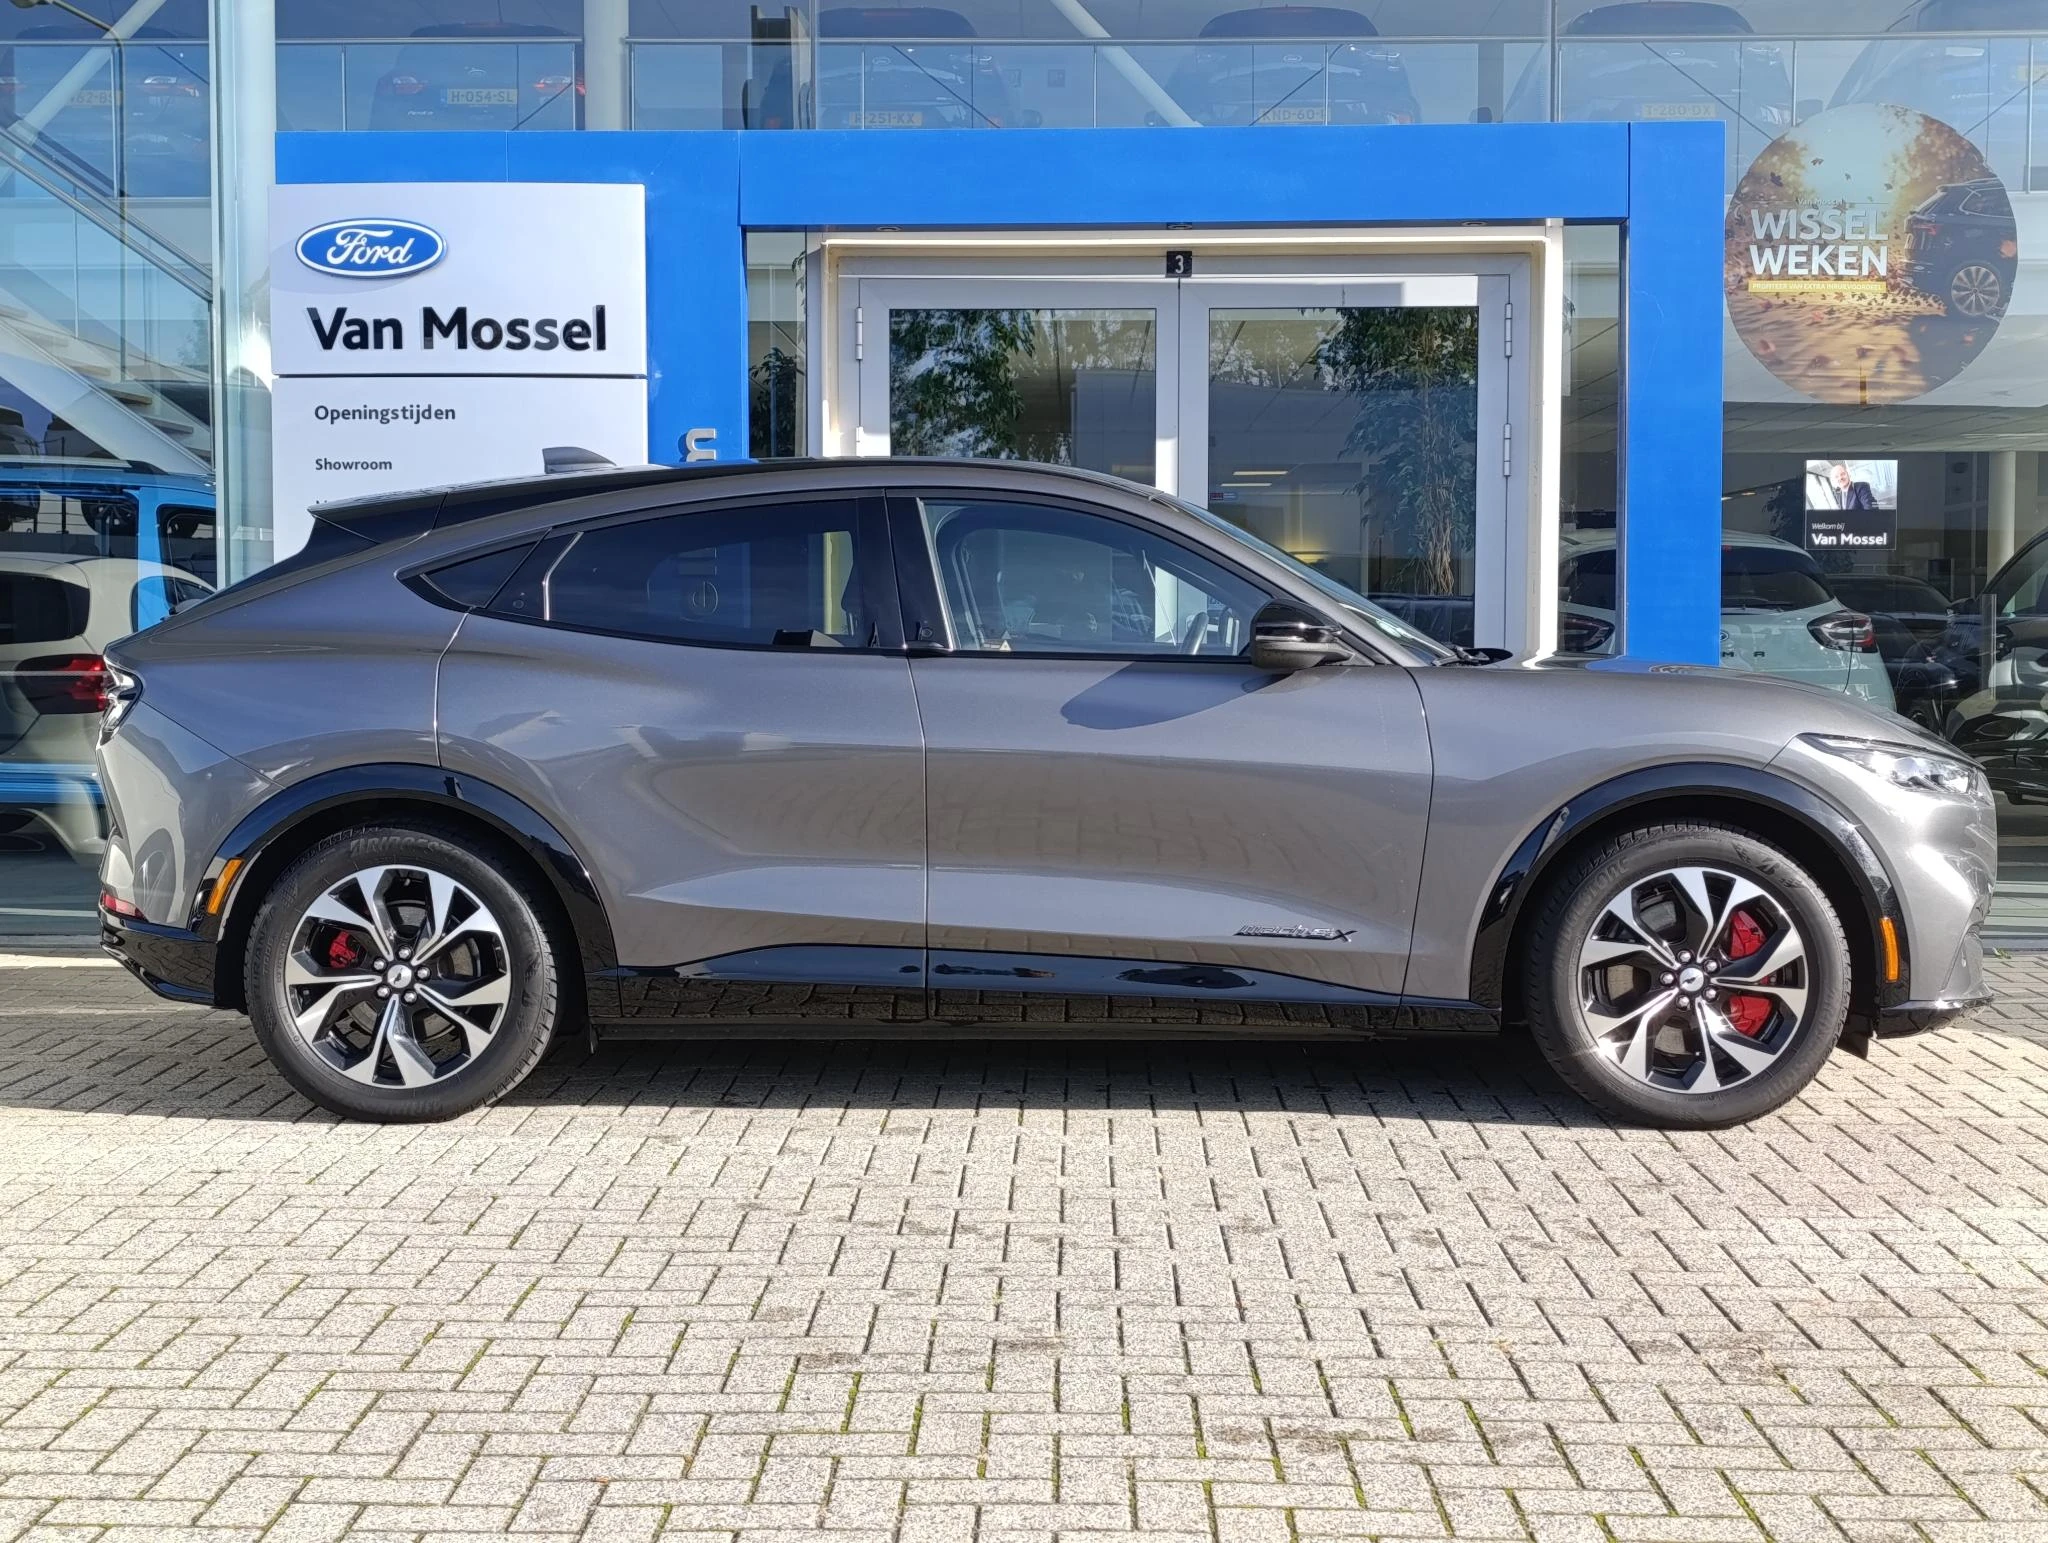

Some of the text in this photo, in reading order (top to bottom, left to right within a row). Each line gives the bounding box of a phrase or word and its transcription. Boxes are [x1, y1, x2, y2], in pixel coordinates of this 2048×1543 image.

[1750, 208, 1889, 240] WISSEL
[326, 228, 415, 265] Ford
[1175, 254, 1184, 274] 3
[1749, 244, 1888, 276] WEKEN
[306, 304, 606, 351] Van Mossel
[314, 404, 456, 425] Openingstijden
[315, 458, 393, 471] Showroom
[1811, 522, 1836, 530] Welkom
[1811, 532, 1887, 545] Van Mossel
